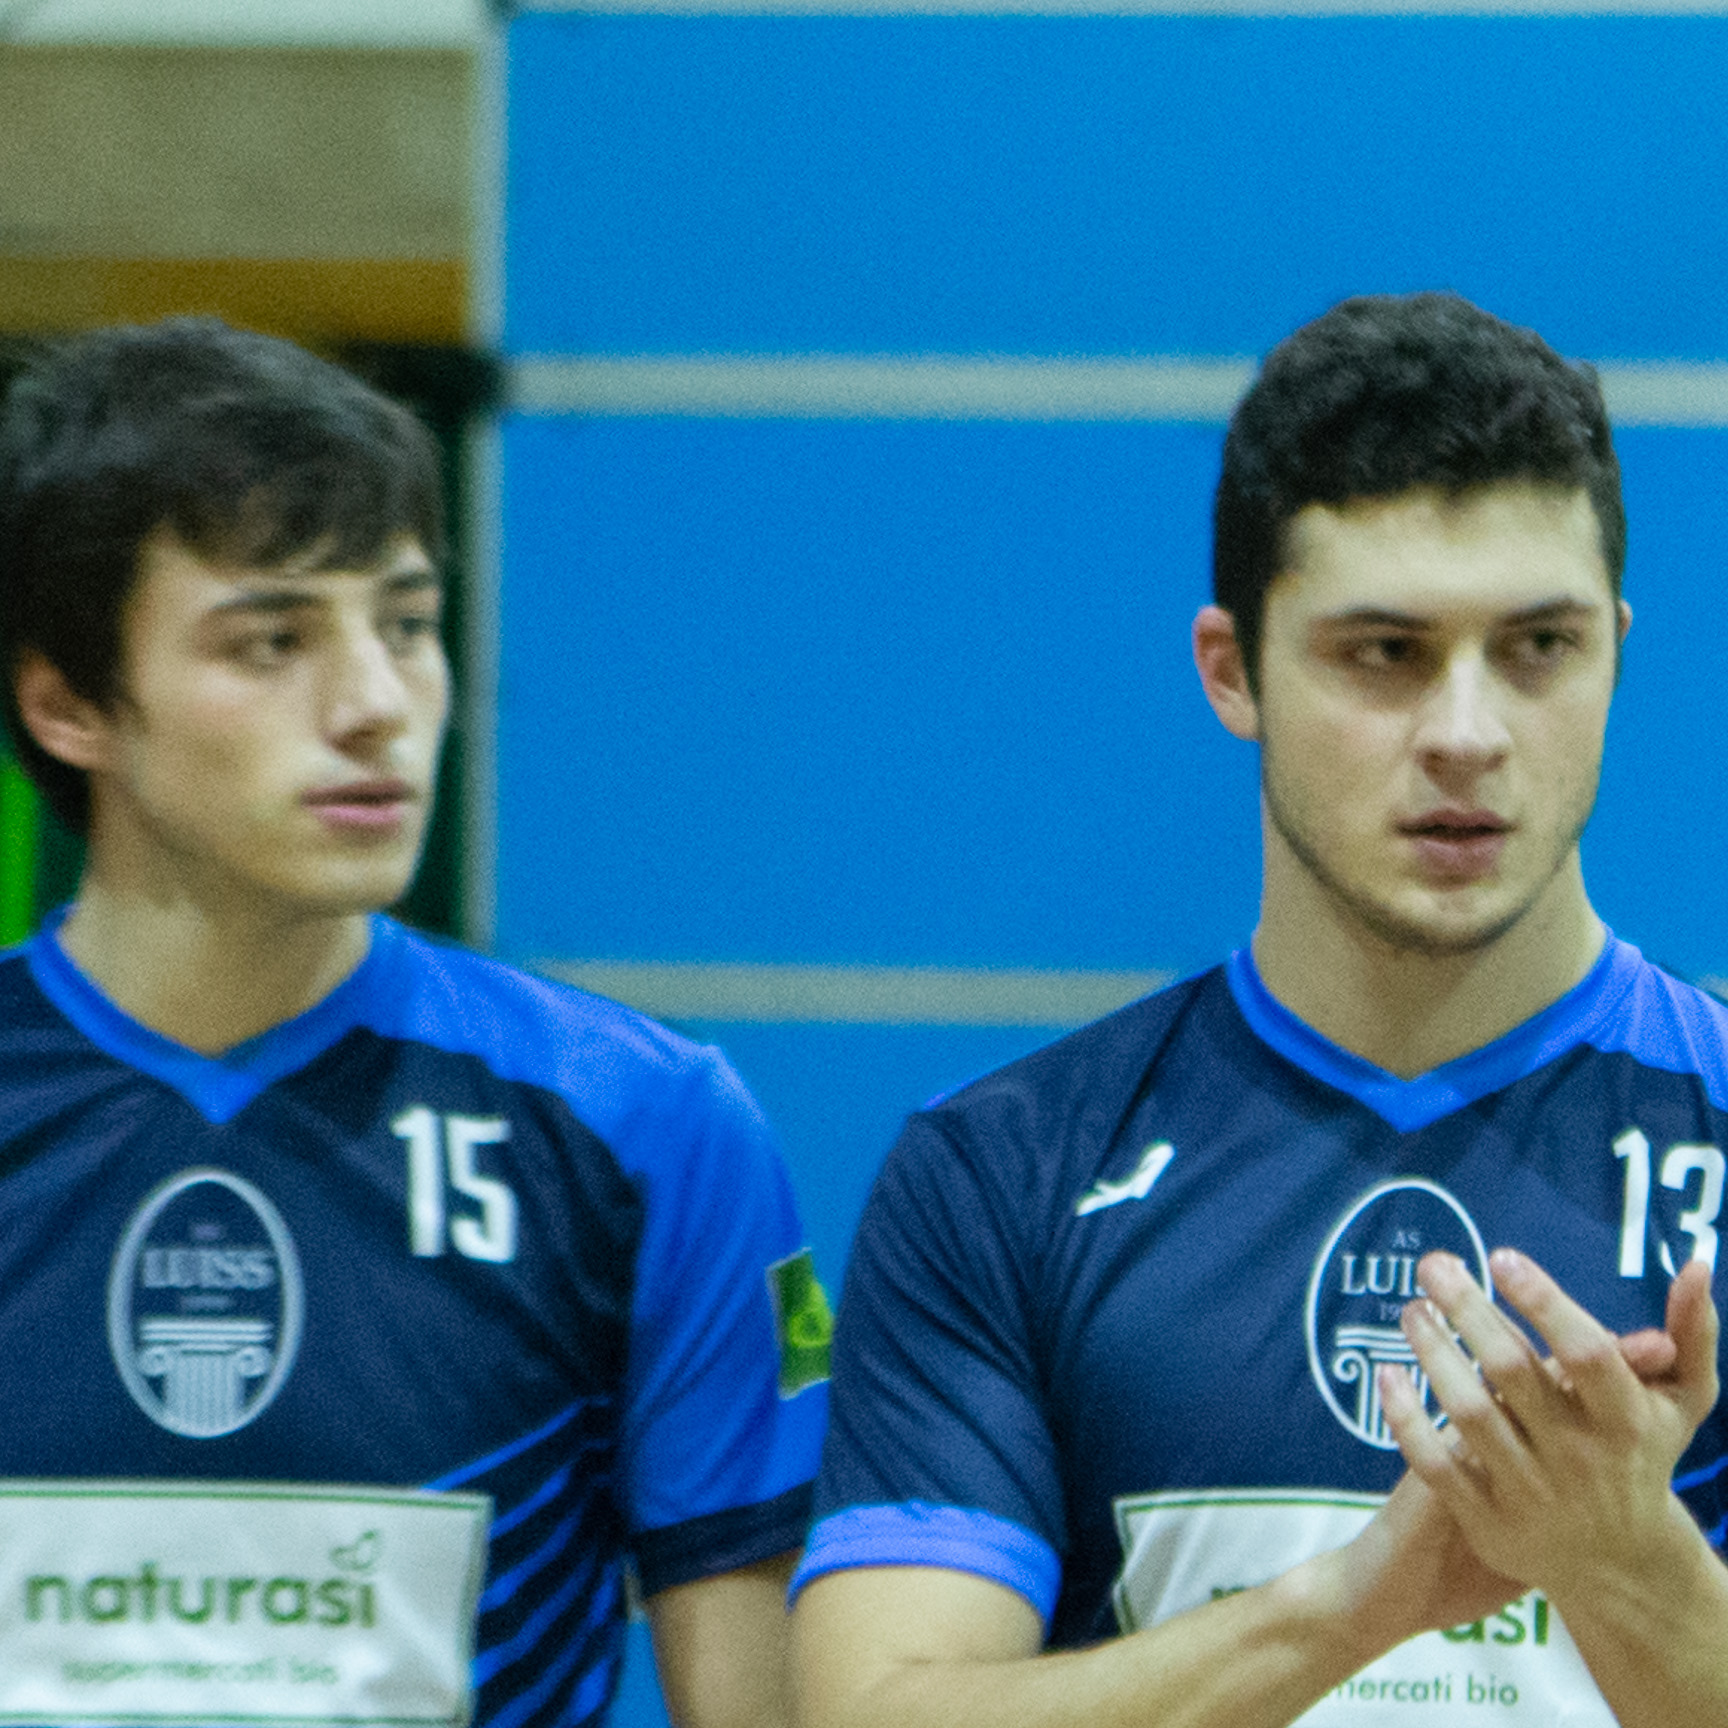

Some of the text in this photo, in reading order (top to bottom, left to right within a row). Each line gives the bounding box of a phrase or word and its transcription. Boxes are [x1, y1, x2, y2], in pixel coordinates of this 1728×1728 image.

[389, 1105, 519, 1264] 15
[1613, 1126, 1727, 1279] 13
[1466, 1674, 1519, 1706] bio
